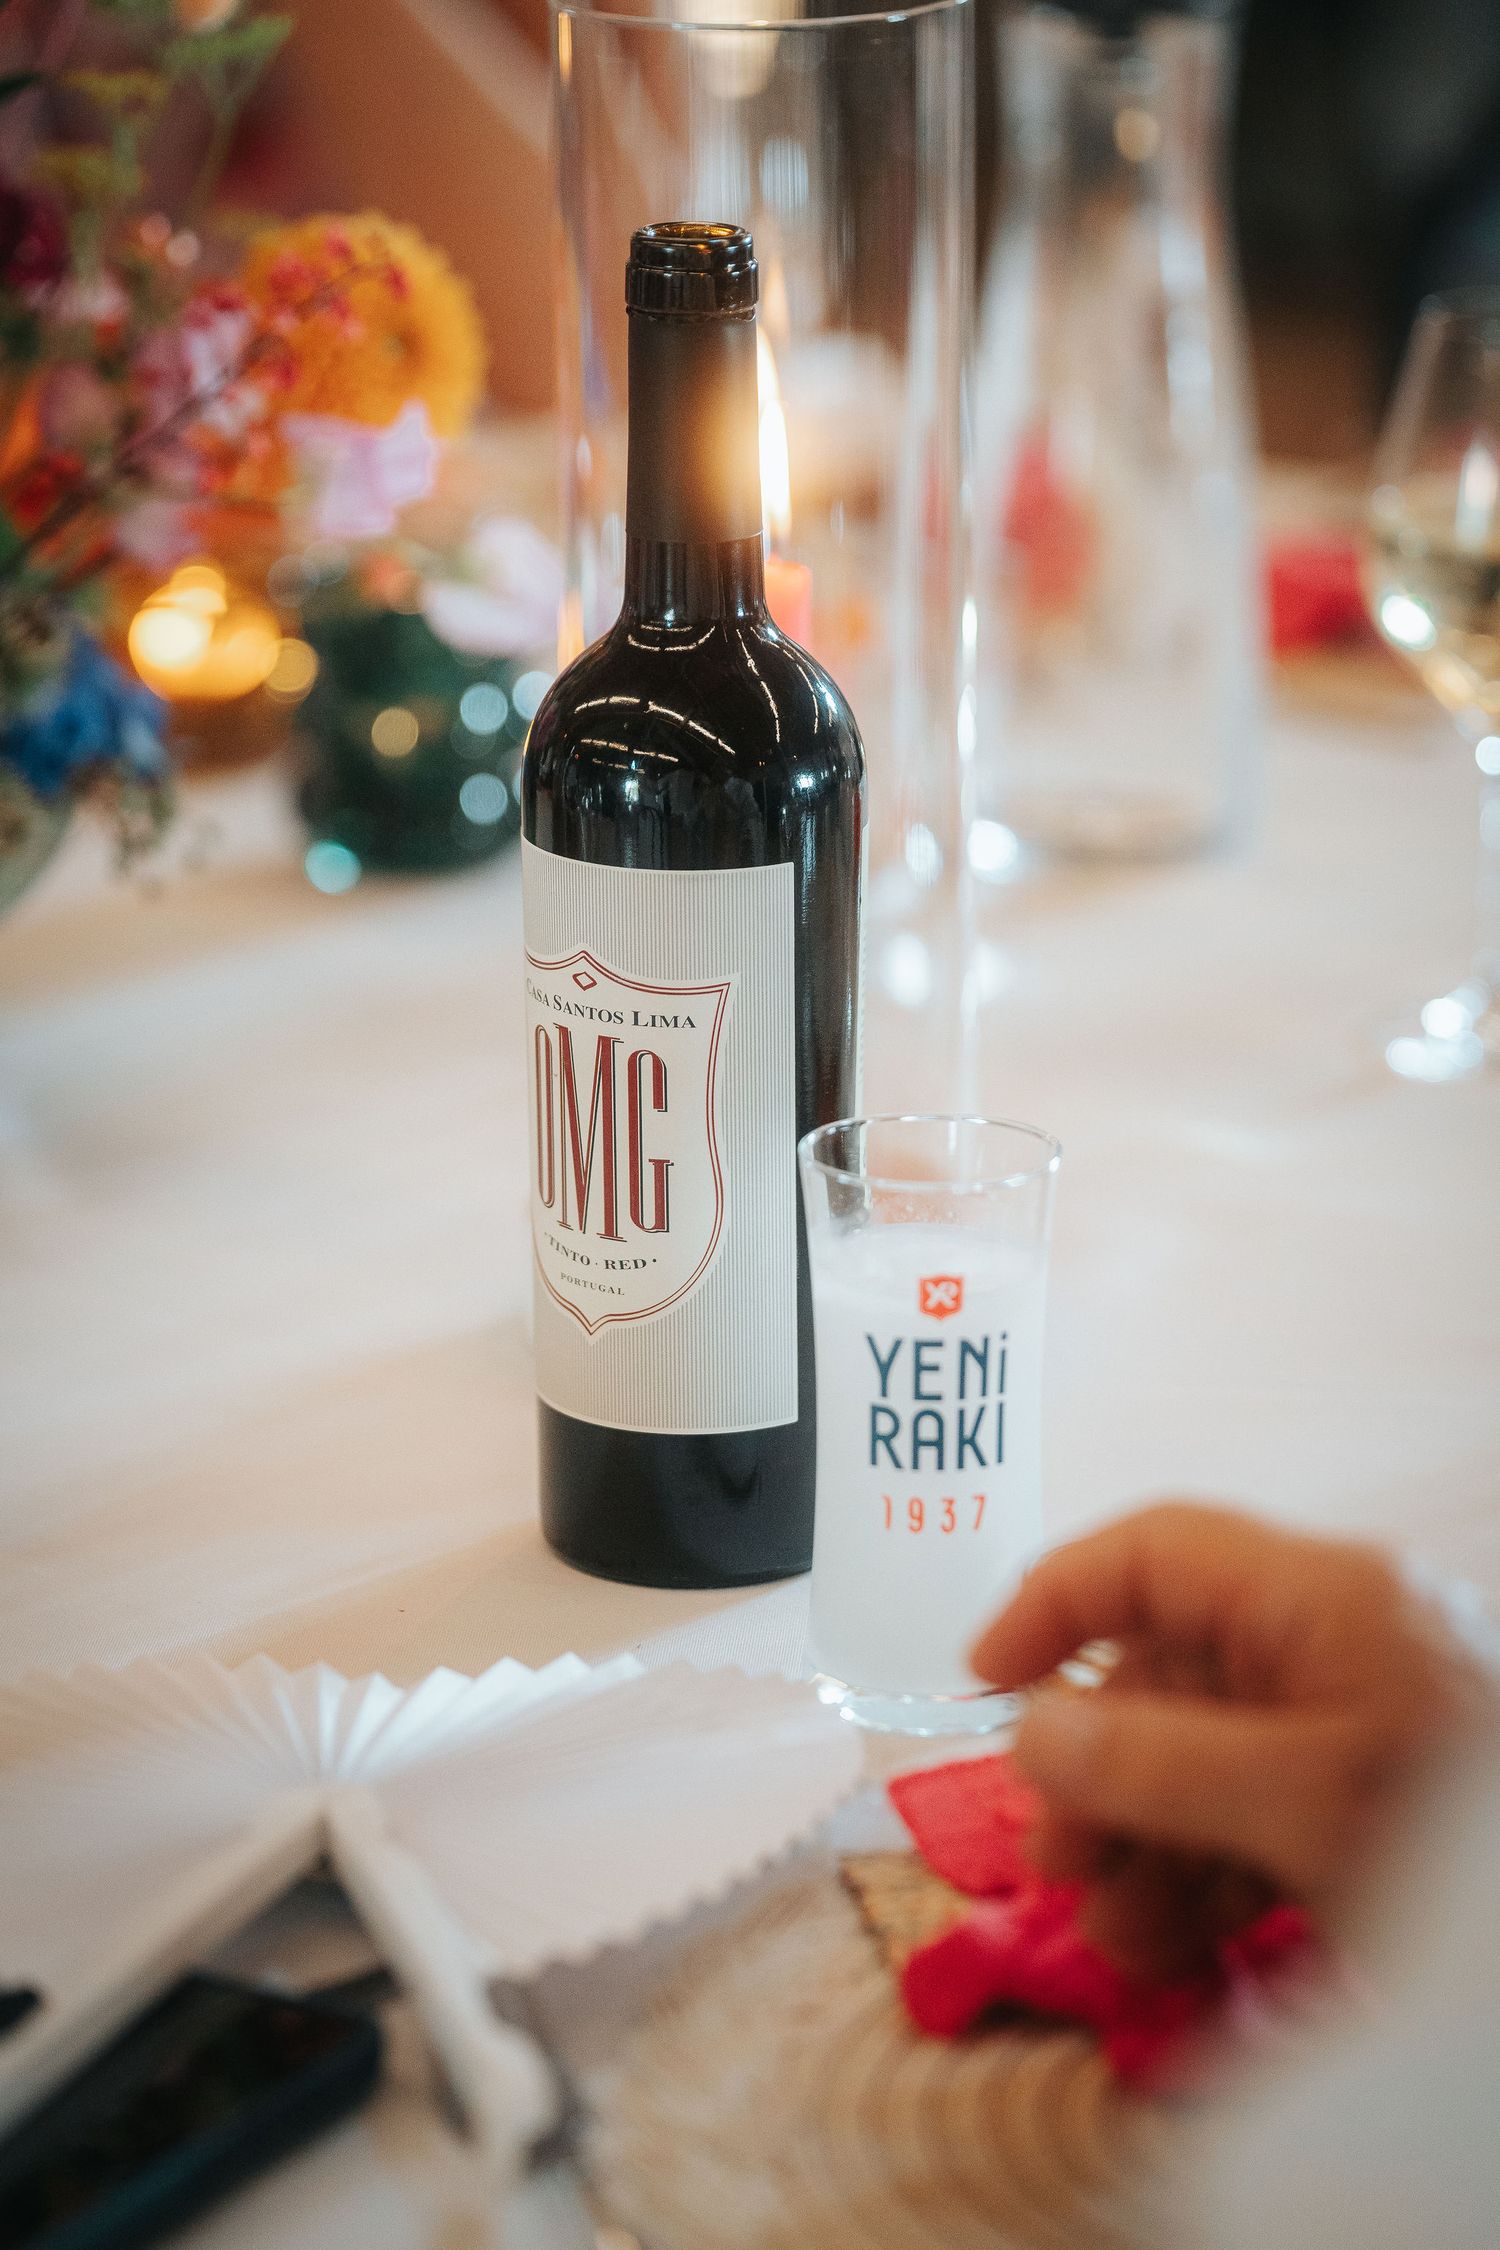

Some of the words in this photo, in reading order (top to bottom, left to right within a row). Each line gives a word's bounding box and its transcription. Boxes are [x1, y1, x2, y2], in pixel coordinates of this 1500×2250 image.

[553, 994, 624, 1025] SANTOS
[631, 1010, 696, 1029] LIMA
[534, 1022, 674, 1242] OMG
[604, 1257, 647, 1271] RED
[560, 1271, 625, 1296] PORTUGAL
[870, 1401, 1004, 1471] RAKI
[882, 1495, 987, 1534] 1937
